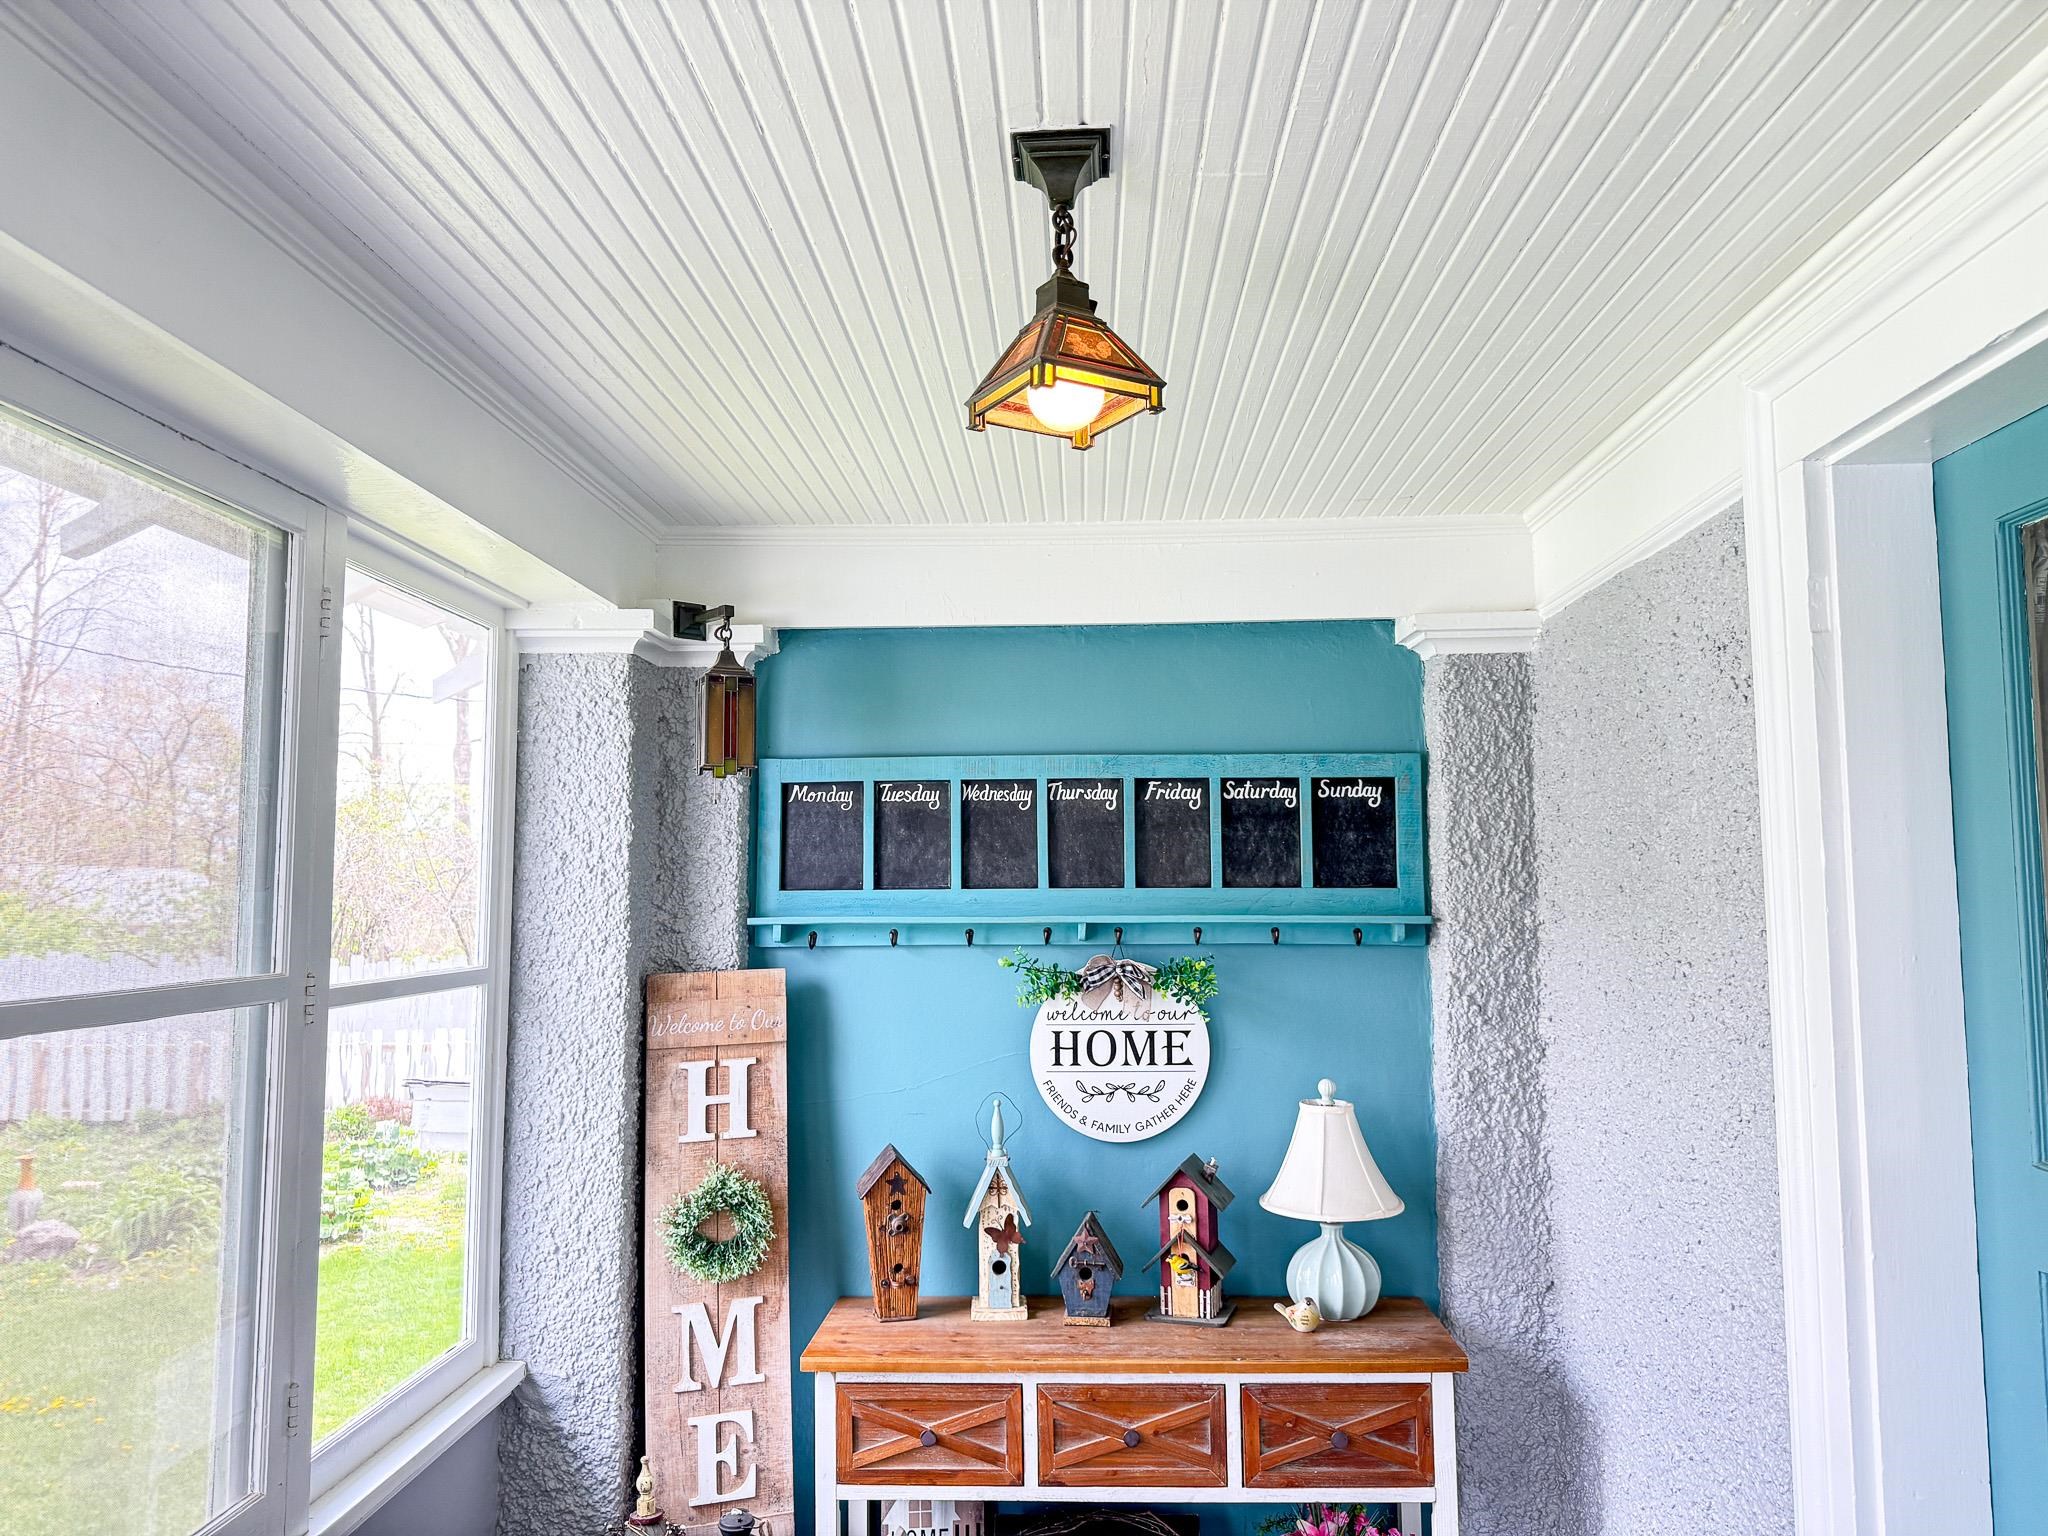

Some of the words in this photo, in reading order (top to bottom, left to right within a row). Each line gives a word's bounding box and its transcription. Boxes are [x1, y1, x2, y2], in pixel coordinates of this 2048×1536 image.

[788, 783, 854, 811] Monday
[880, 783, 940, 810] Tuesday
[962, 783, 1032, 811] Wednesday
[1048, 782, 1118, 811] Thursday
[1144, 781, 1202, 810] Friday
[1223, 780, 1297, 809] Saturday
[1317, 779, 1383, 808] Sunday
[649, 1013, 725, 1037] Welcome
[729, 1013, 747, 1032] to
[751, 1008, 784, 1031] Our
[1046, 1001, 1128, 1021] welcome
[1132, 1001, 1155, 1022] to
[1157, 1006, 1198, 1021] our
[1050, 1029, 1194, 1067] HOME
[1043, 1079, 1079, 1120] FRIENDS
[1079, 1115, 1088, 1126] &
[1090, 1120, 1132, 1134] FAMILY
[1135, 1104, 1178, 1132] GATHER
[1176, 1078, 1197, 1106] HERE
